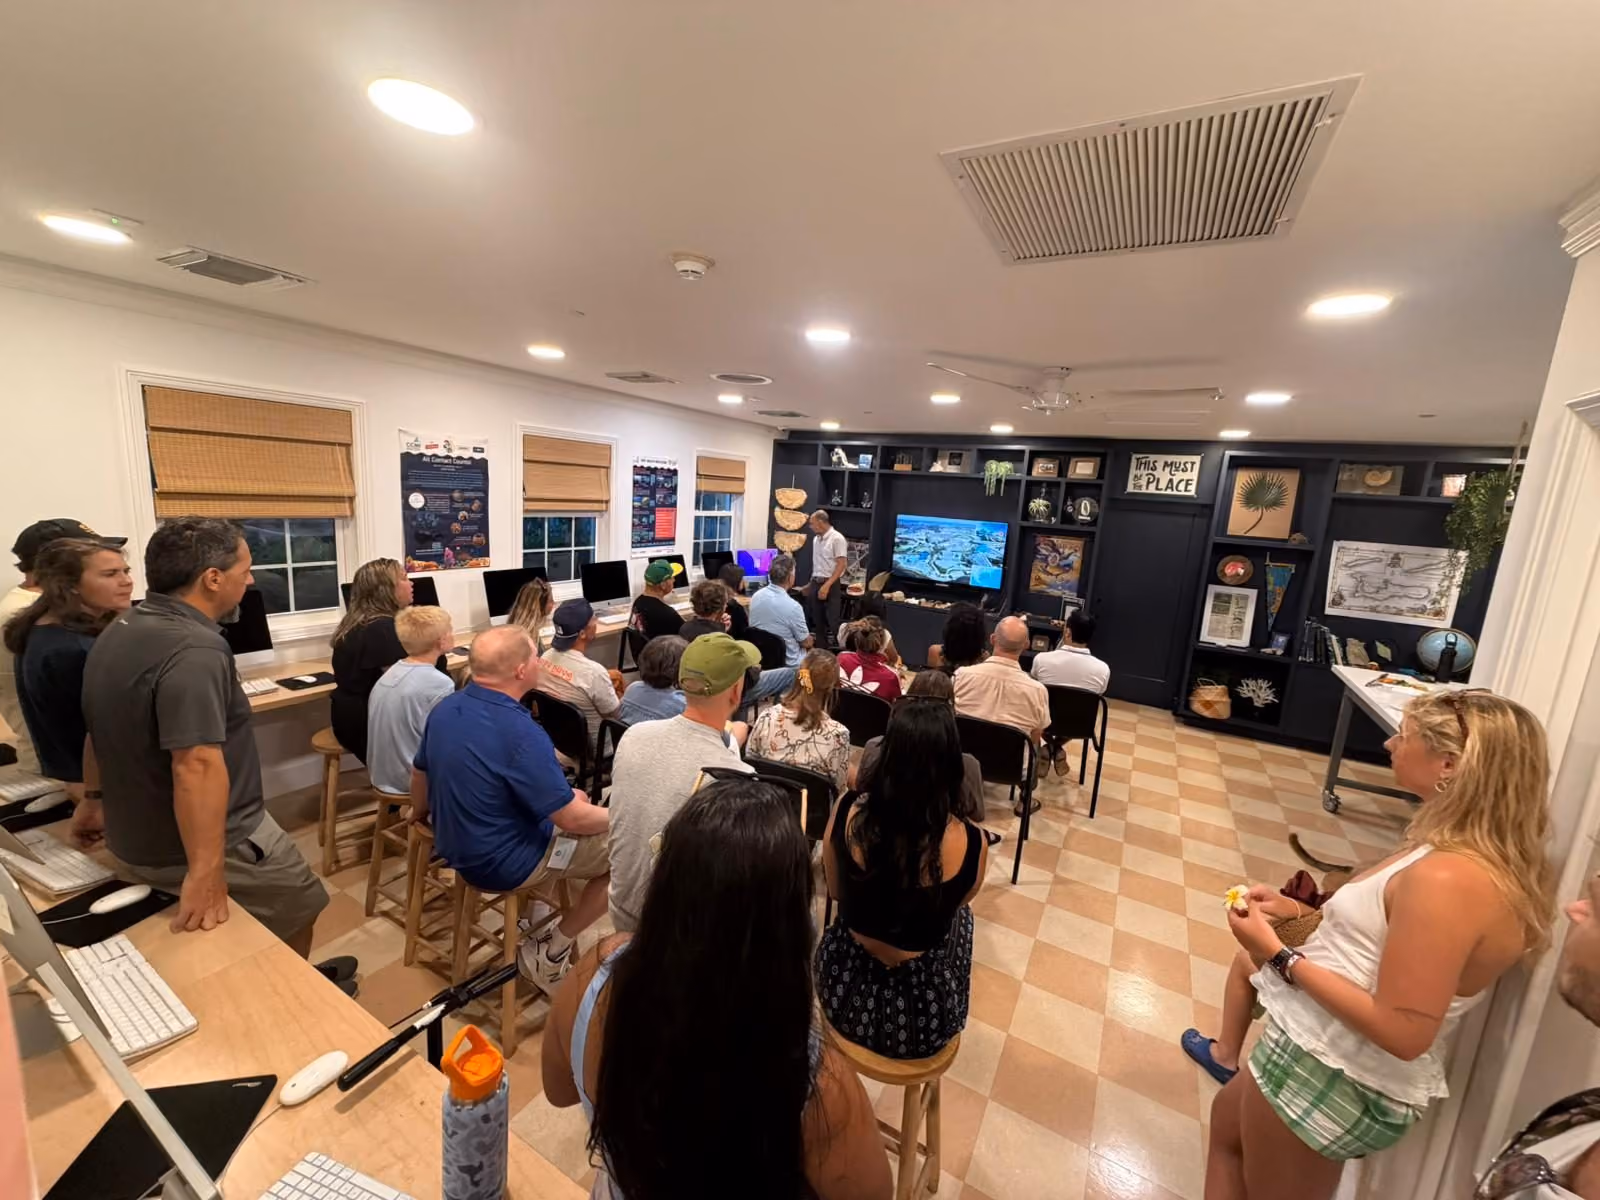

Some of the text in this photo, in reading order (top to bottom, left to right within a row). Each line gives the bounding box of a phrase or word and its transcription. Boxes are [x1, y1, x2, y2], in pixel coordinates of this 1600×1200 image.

[431, 456, 452, 464] Contact
[1135, 456, 1197, 476] THIS MUST
[1145, 472, 1195, 492] PLACE
